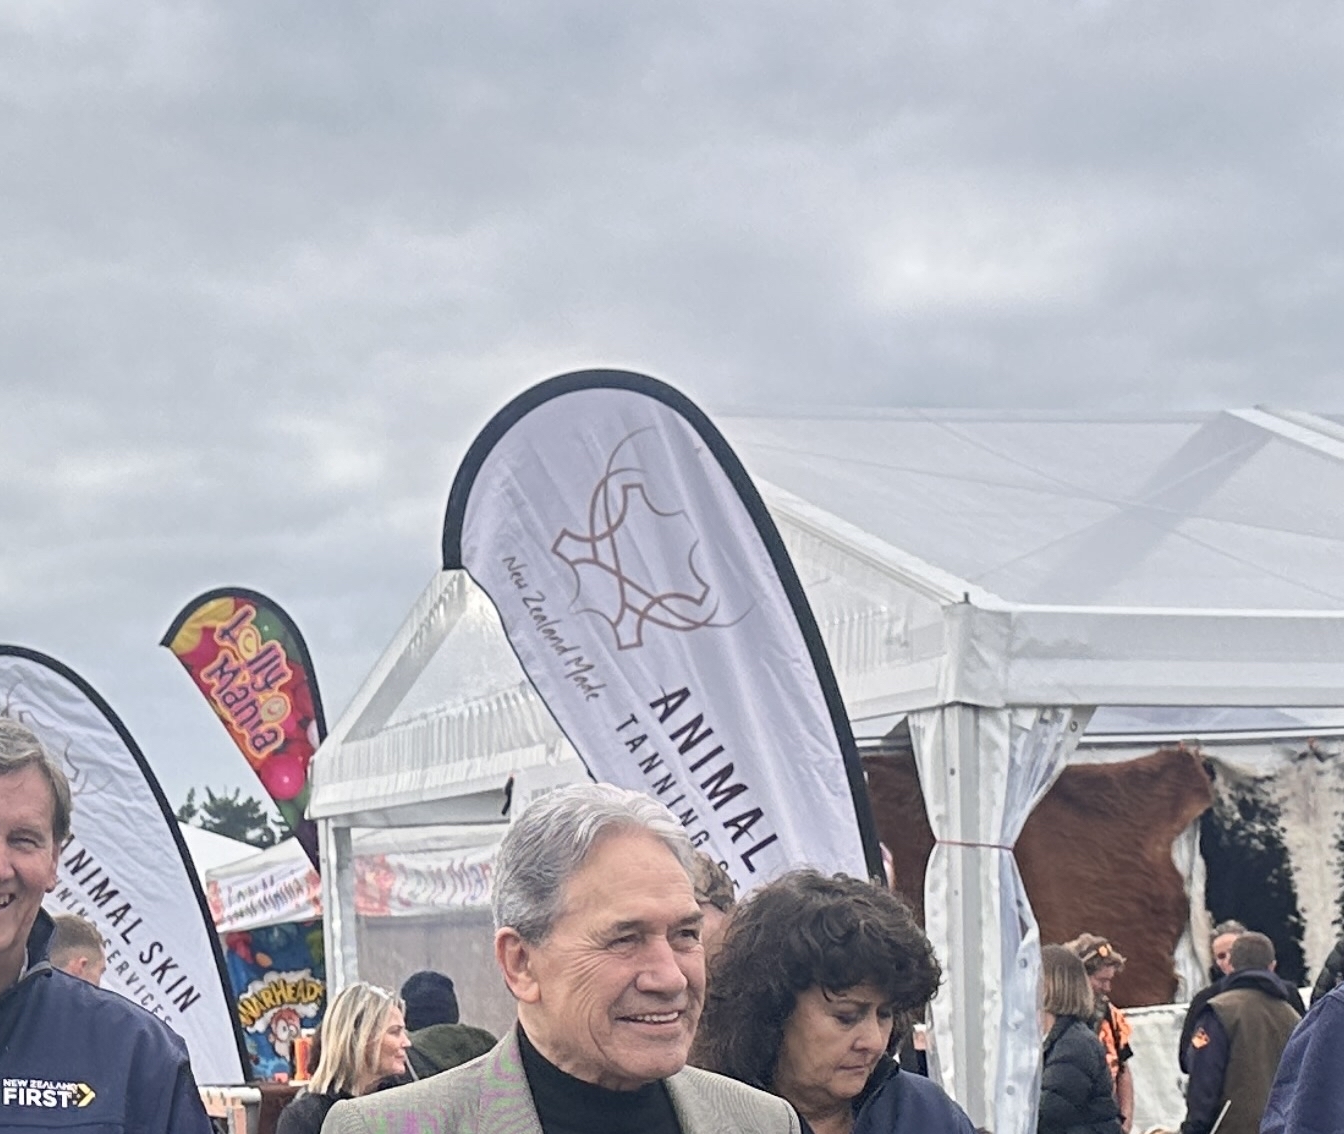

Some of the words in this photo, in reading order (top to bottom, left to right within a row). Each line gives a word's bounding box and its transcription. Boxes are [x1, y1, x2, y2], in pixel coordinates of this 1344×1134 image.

[215, 607, 289, 693] Lolly
[502, 556, 528, 590] New
[522, 590, 581, 657] Zealand
[564, 656, 607, 702] Made
[205, 653, 290, 752] Mania
[615, 712, 711, 849] TANNING
[648, 686, 778, 874] ANIMAL
[139, 940, 202, 1013] SKIN
[2, 1078, 29, 1087] NEW
[29, 1079, 77, 1094] ZEALAND
[2, 1087, 72, 1108] FIRST
